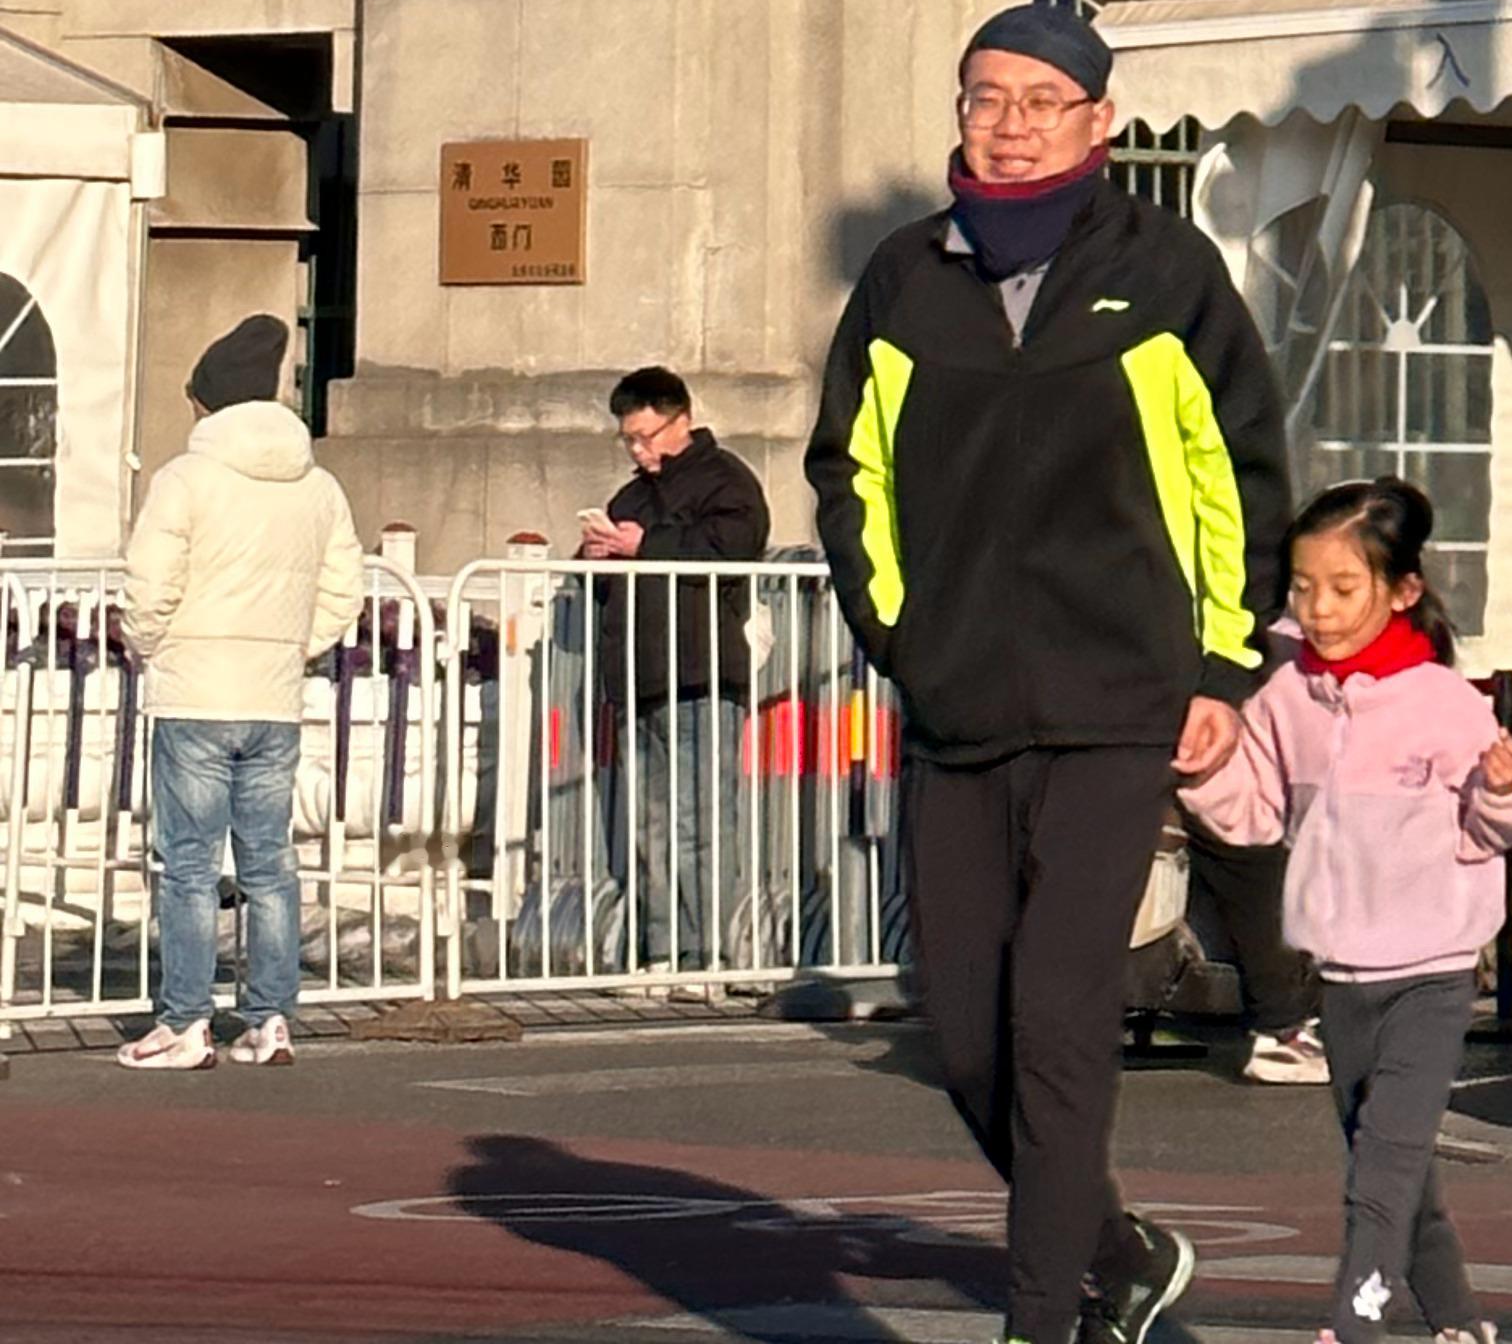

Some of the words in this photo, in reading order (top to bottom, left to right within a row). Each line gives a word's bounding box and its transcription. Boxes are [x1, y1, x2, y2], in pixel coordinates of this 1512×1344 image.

[452, 159, 572, 191] 清华园
[489, 223, 532, 251] 西门
